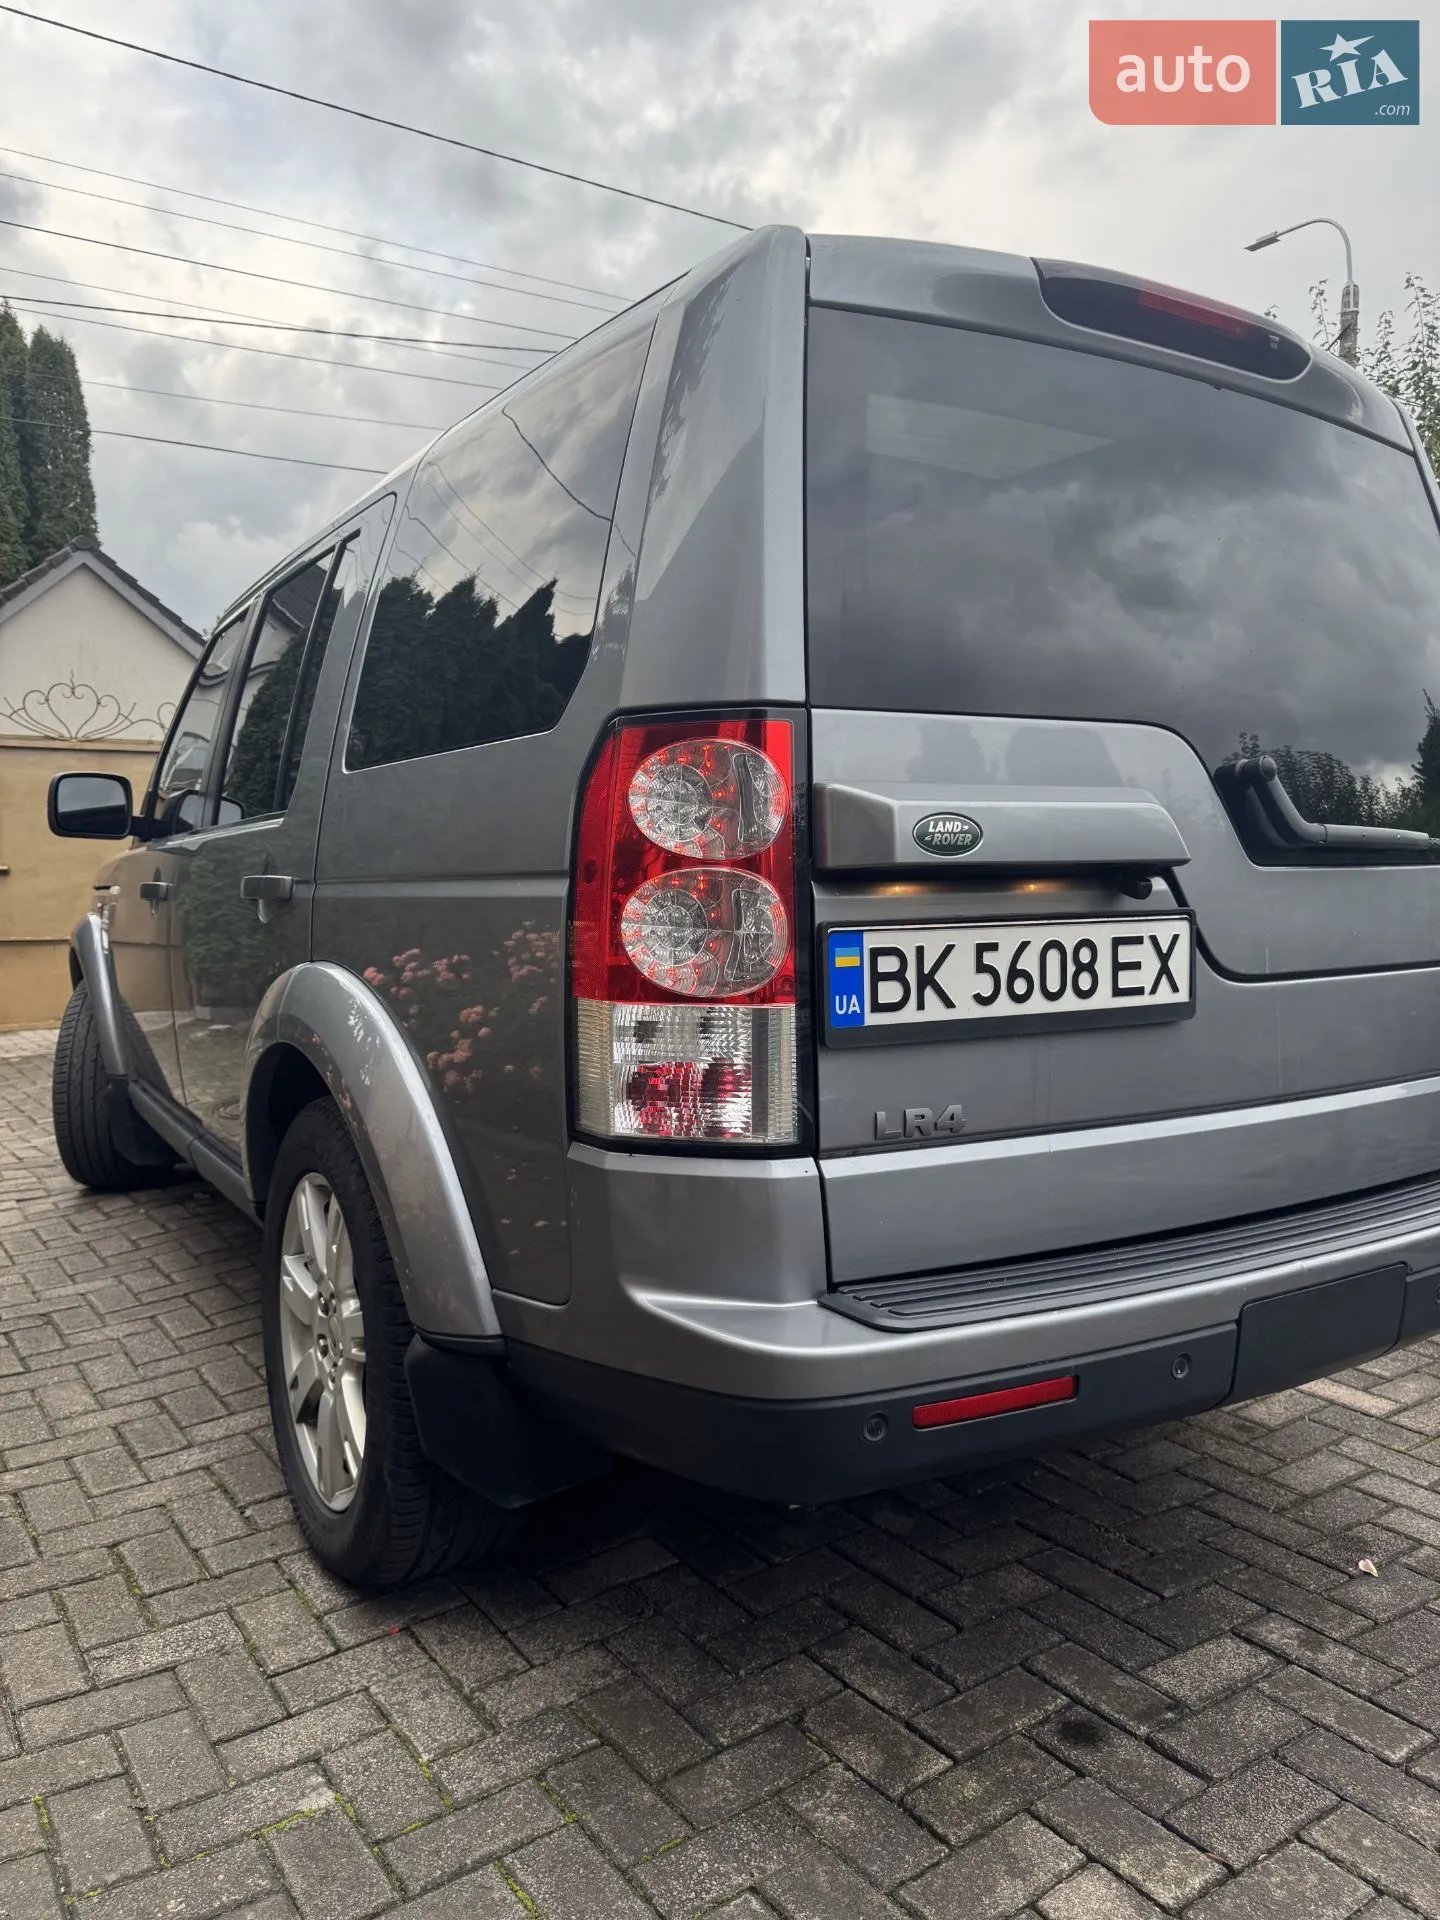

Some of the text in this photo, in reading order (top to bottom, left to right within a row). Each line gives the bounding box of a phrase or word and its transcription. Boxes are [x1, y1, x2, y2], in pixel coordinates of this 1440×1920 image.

[928, 820, 962, 833] LAND
[932, 833, 973, 846] ROVER
[868, 933, 1181, 1014] BK 5608 EX
[834, 994, 861, 1015] UA
[874, 1104, 967, 1141] LR4
